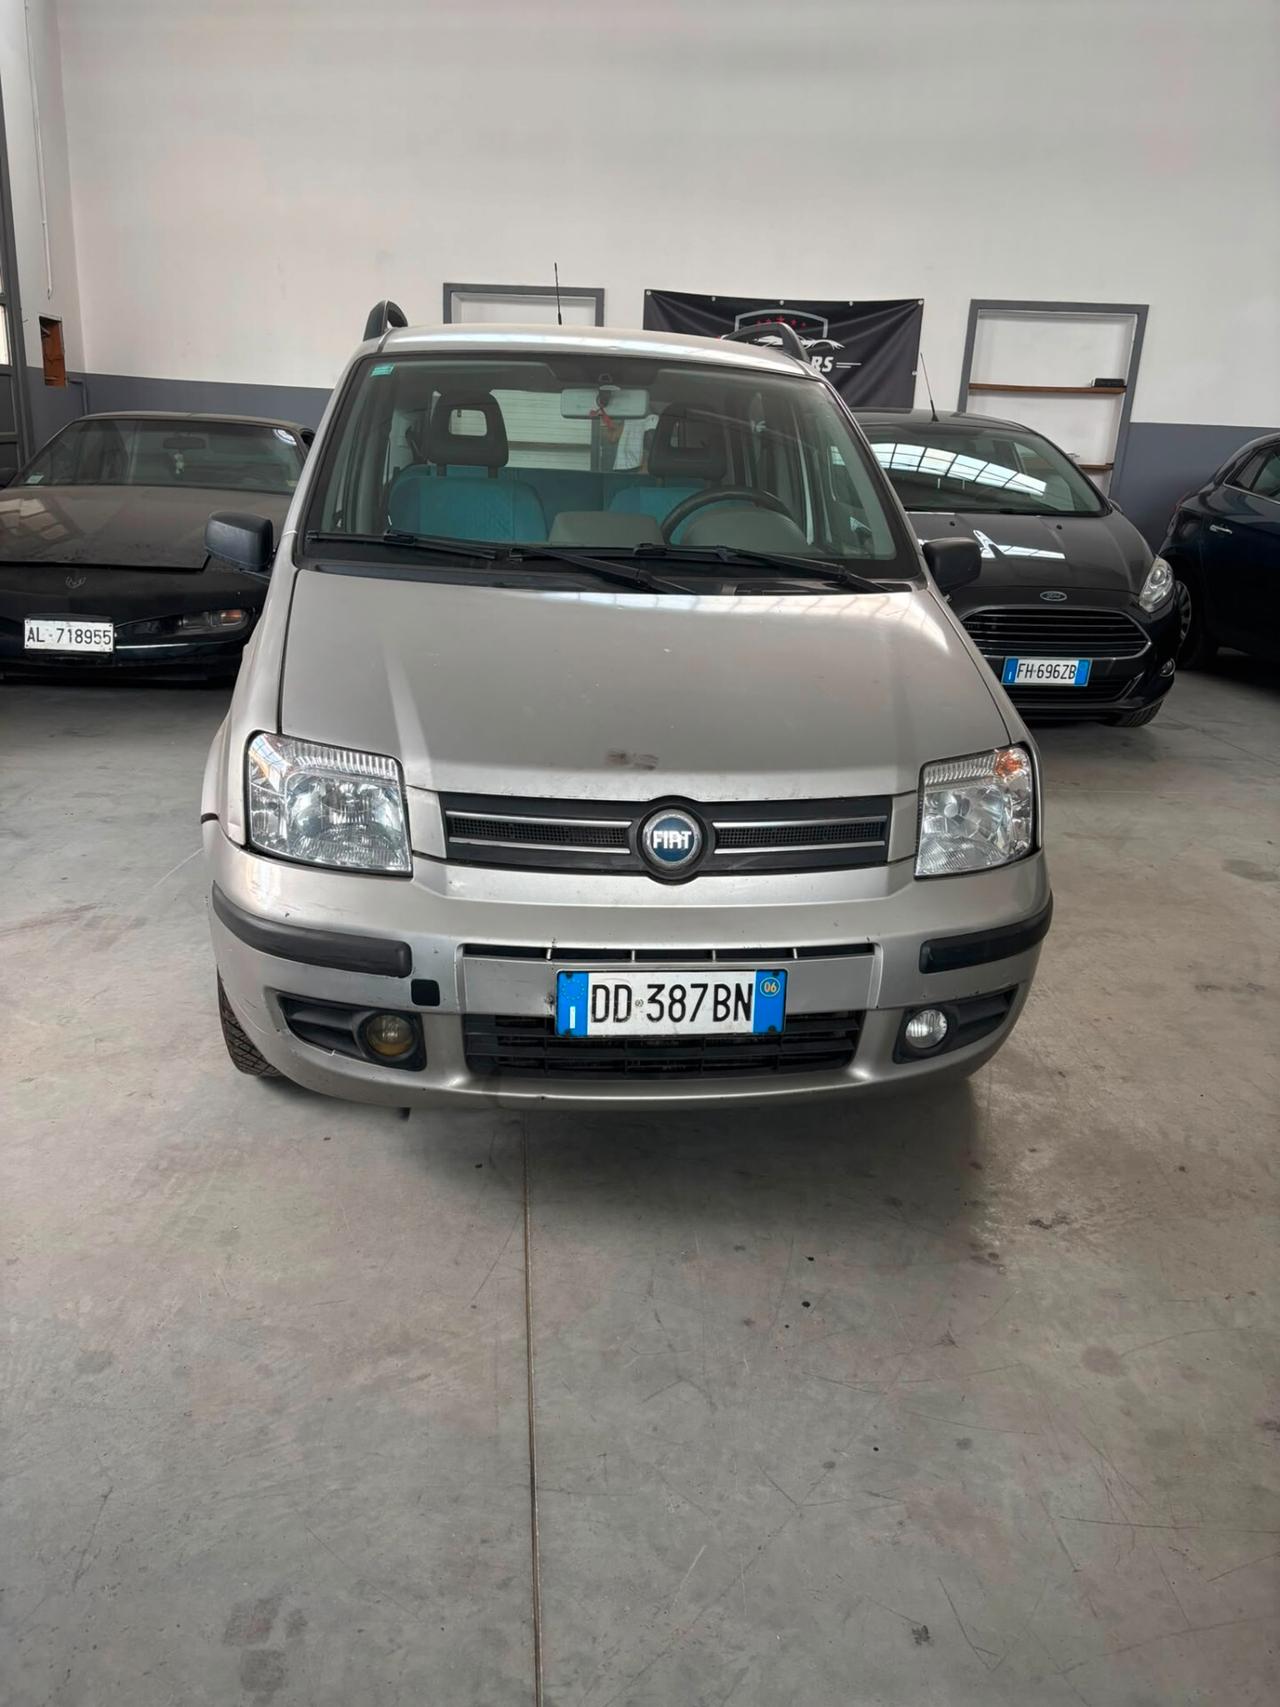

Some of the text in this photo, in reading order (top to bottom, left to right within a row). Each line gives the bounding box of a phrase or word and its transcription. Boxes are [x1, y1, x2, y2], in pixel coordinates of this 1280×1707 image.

[810, 355, 834, 373] RS
[653, 830, 692, 849] FIAT
[763, 982, 777, 993] 06
